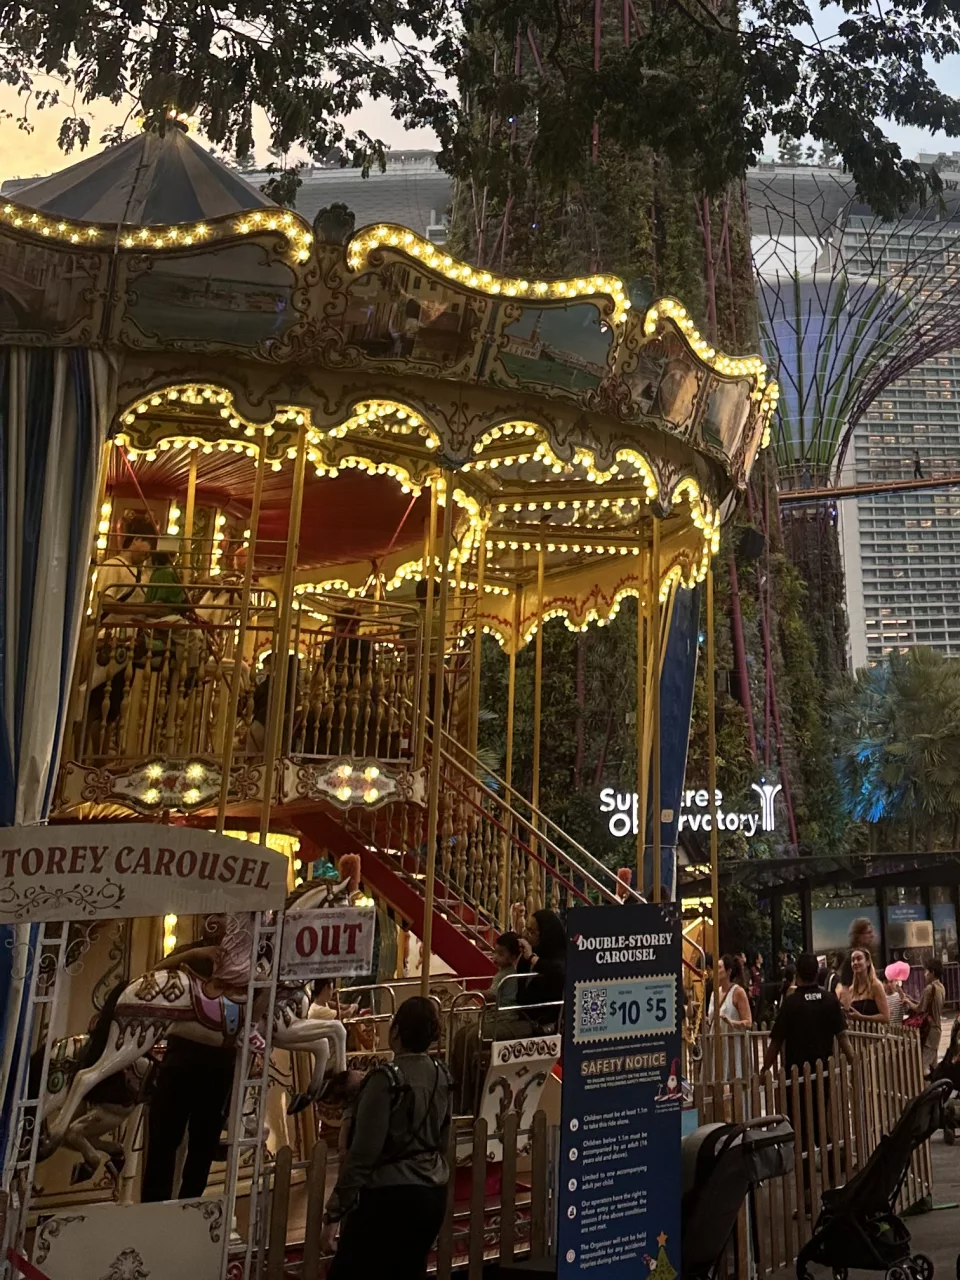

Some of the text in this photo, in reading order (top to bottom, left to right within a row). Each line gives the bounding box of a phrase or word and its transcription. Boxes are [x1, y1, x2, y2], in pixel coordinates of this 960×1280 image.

[600, 788, 722, 812] Suree
[609, 808, 758, 837] Orvatory
[115, 846, 270, 890] CAROUSEL
[296, 923, 362, 957] OUT
[578, 933, 673, 951] DOUBLE-STOREY
[596, 949, 656, 964] CAROUSEL
[610, 1000, 640, 1025] $10
[647, 997, 666, 1022] $5
[581, 1052, 667, 1076] SAFETY NOTICE
[583, 1114, 602, 1122] Children
[583, 1139, 602, 1147] Children
[583, 1145, 612, 1156] accompanied
[583, 1158, 594, 1166] years
[603, 1153, 611, 1161] and
[582, 1173, 599, 1181] Limited
[616, 1166, 647, 1175] accompanying
[582, 1182, 593, 1190] adult
[591, 1197, 612, 1206] operators
[632, 1191, 641, 1199] right
[617, 1201, 638, 1209] terminate
[625, 1207, 647, 1216] conditions
[637, 1231, 646, 1239] held
[580, 1249, 606, 1259] responsible
[624, 1240, 646, 1250] accidental
[580, 1261, 596, 1269] injuries
[597, 1257, 612, 1265] during
